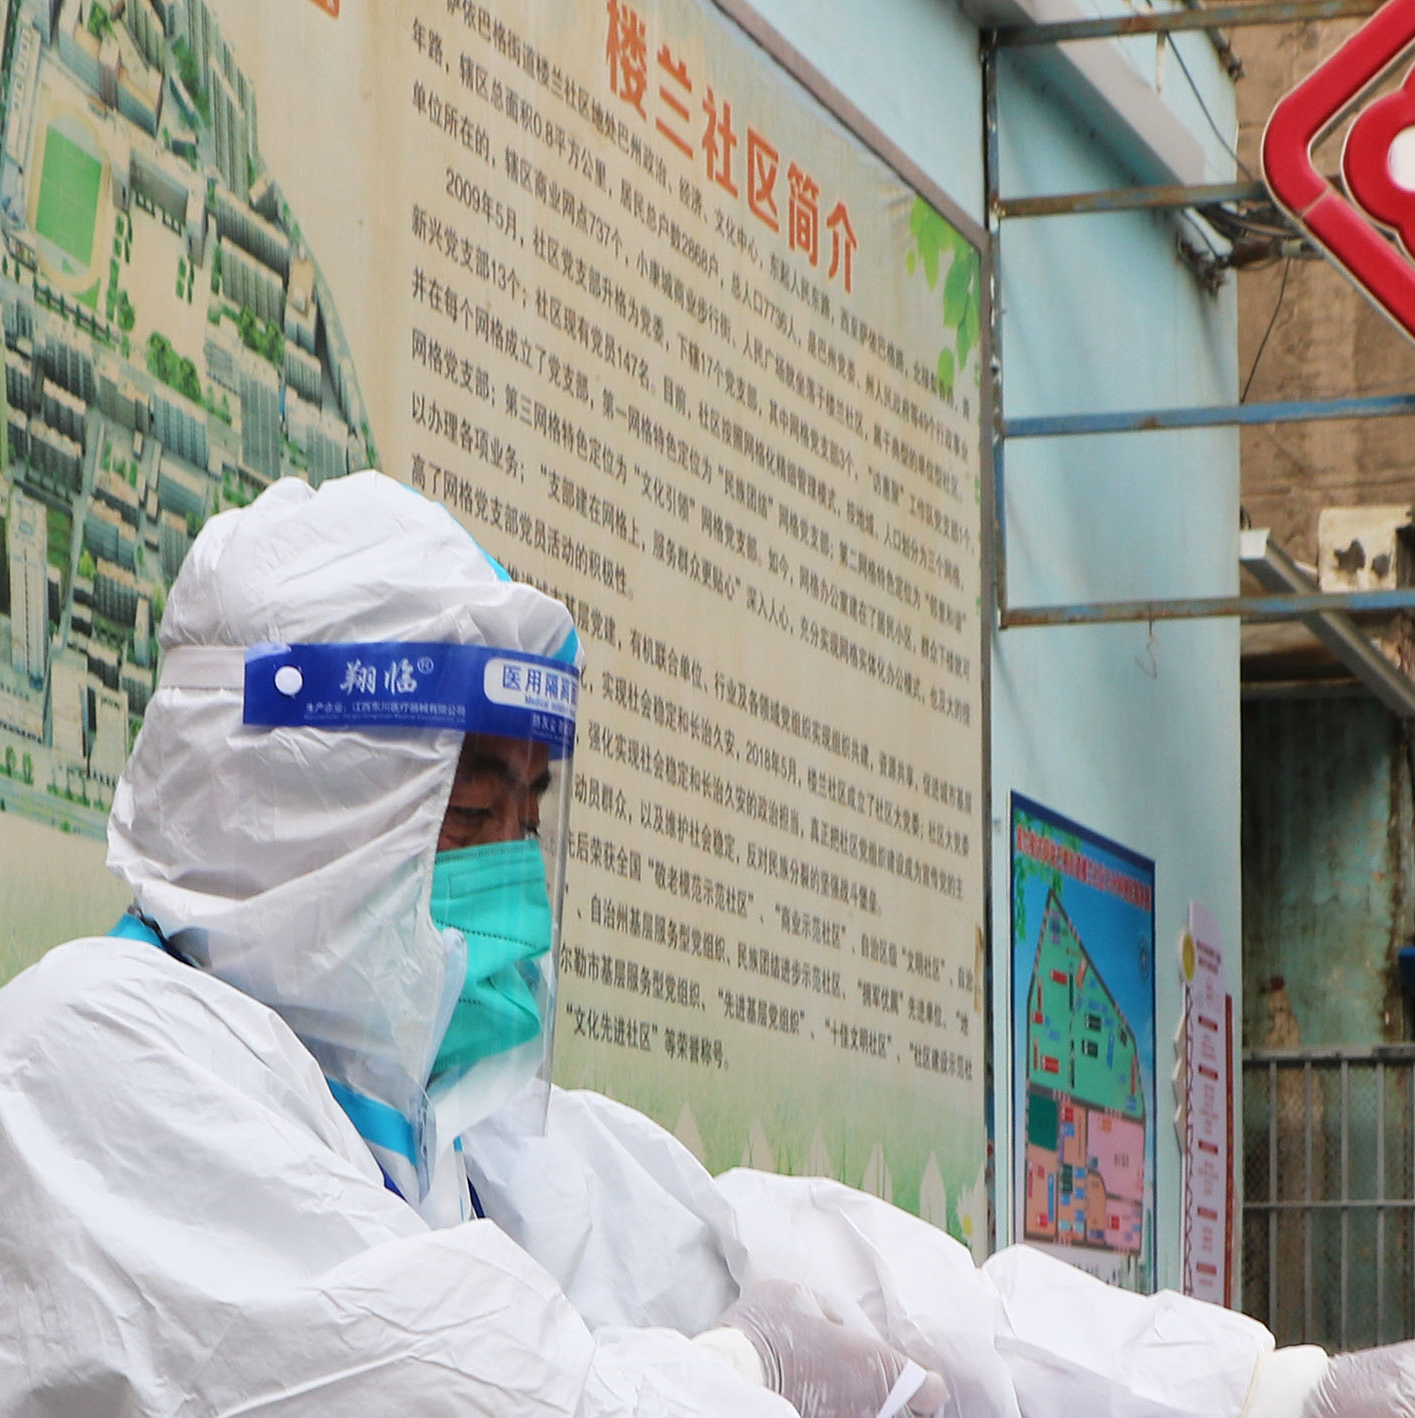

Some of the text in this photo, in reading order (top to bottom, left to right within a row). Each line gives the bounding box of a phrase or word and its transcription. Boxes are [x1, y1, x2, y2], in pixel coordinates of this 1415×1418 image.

[604, 0, 859, 293] 楼兰社区简介
